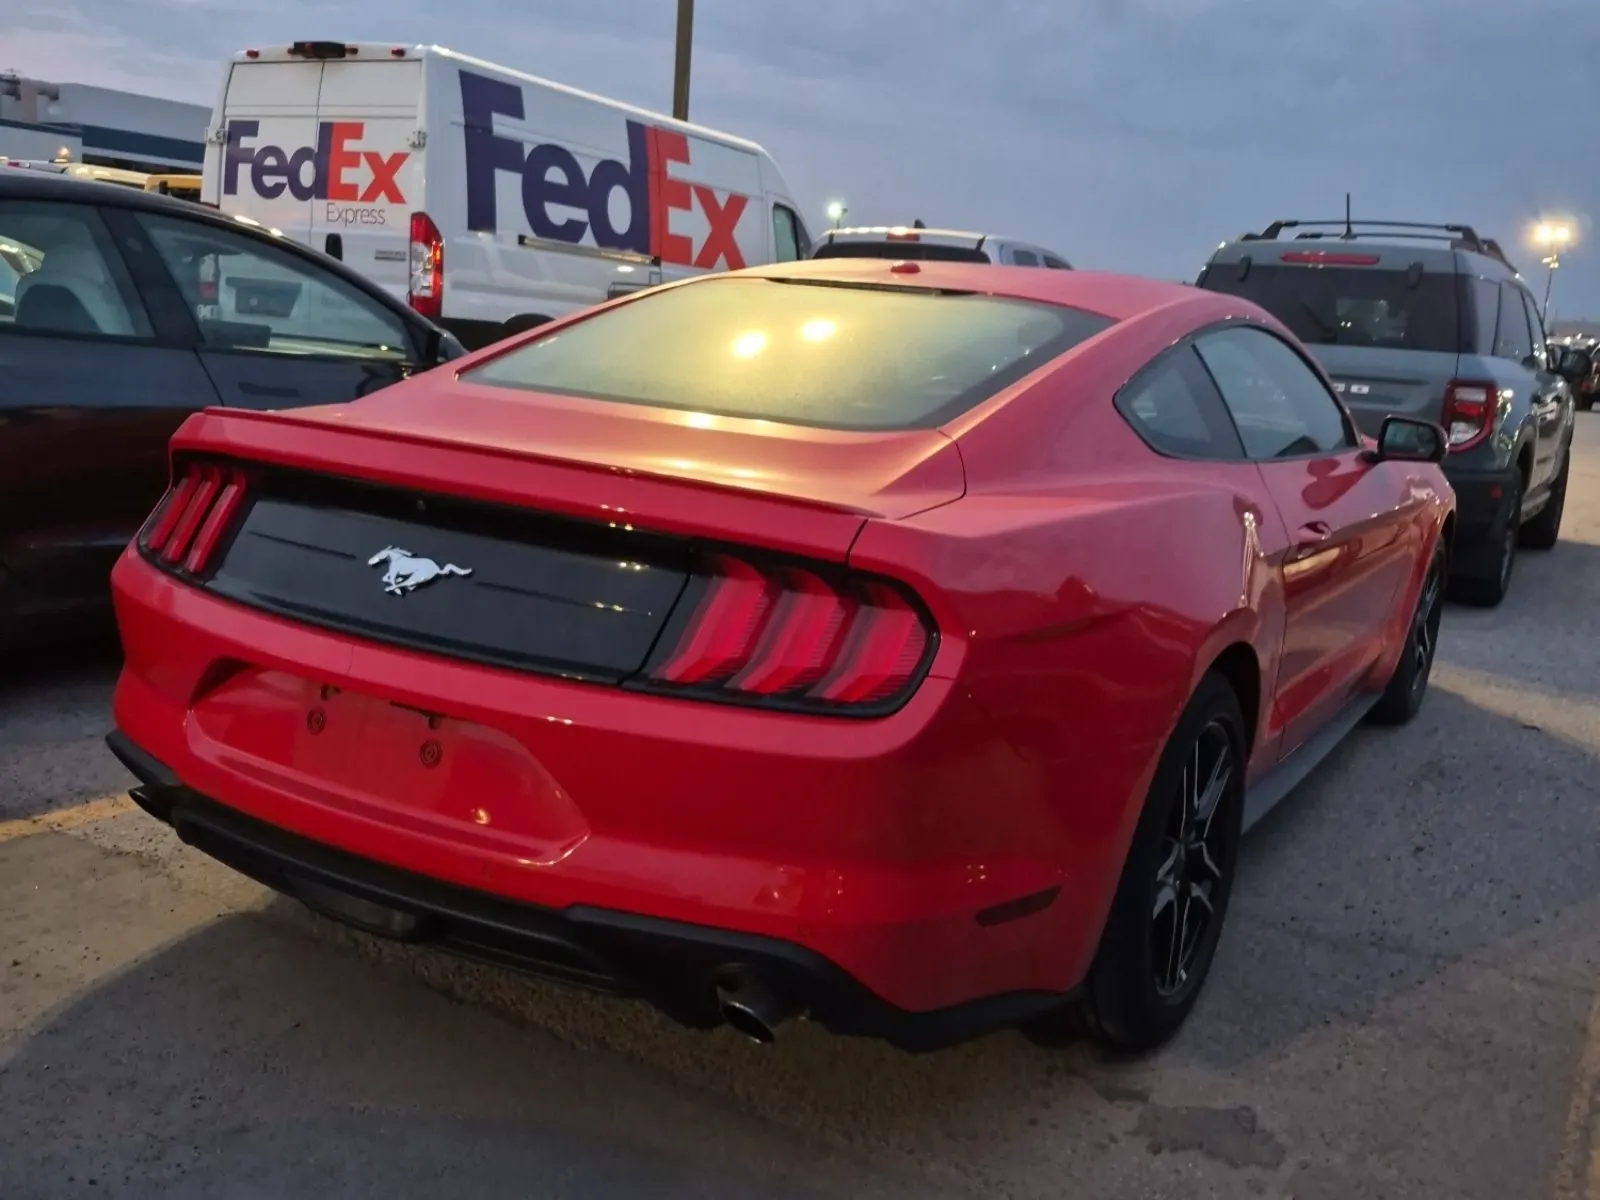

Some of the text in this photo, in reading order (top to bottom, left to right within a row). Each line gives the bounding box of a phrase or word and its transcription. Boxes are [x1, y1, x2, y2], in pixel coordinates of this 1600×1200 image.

[223, 120, 410, 204] FedEx
[459, 70, 748, 271] FedEx
[326, 202, 386, 228] Express
